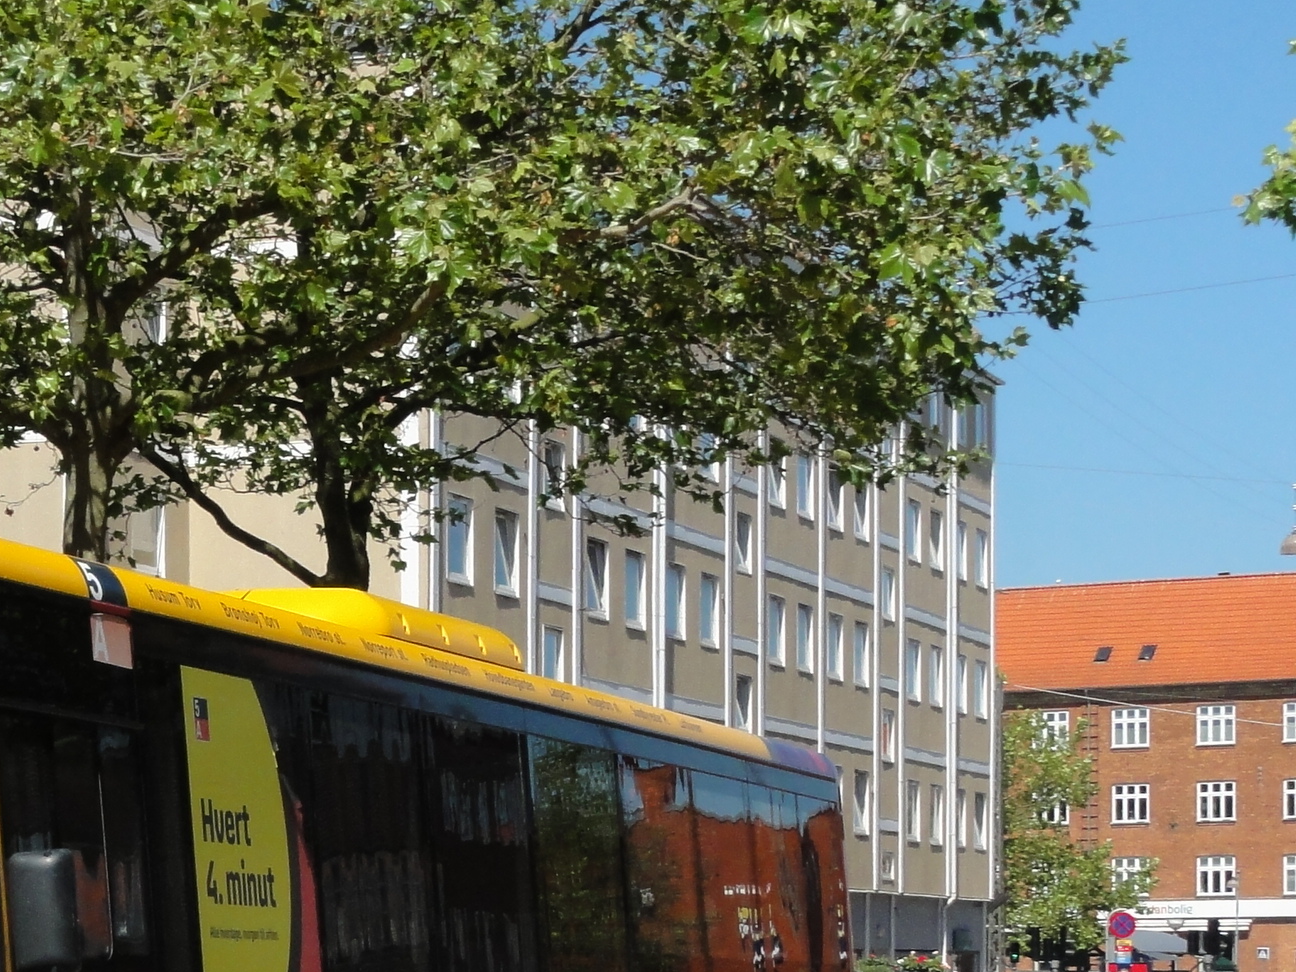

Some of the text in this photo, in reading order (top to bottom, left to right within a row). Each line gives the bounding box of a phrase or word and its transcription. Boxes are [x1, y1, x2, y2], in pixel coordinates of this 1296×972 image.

[76, 560, 104, 601] 5
[145, 583, 203, 611] Husum Torv
[91, 613, 109, 662] A
[259, 612, 281, 630] Torv
[194, 699, 201, 719] 5
[200, 797, 252, 847] Hvert
[206, 859, 277, 908] 4. minut
